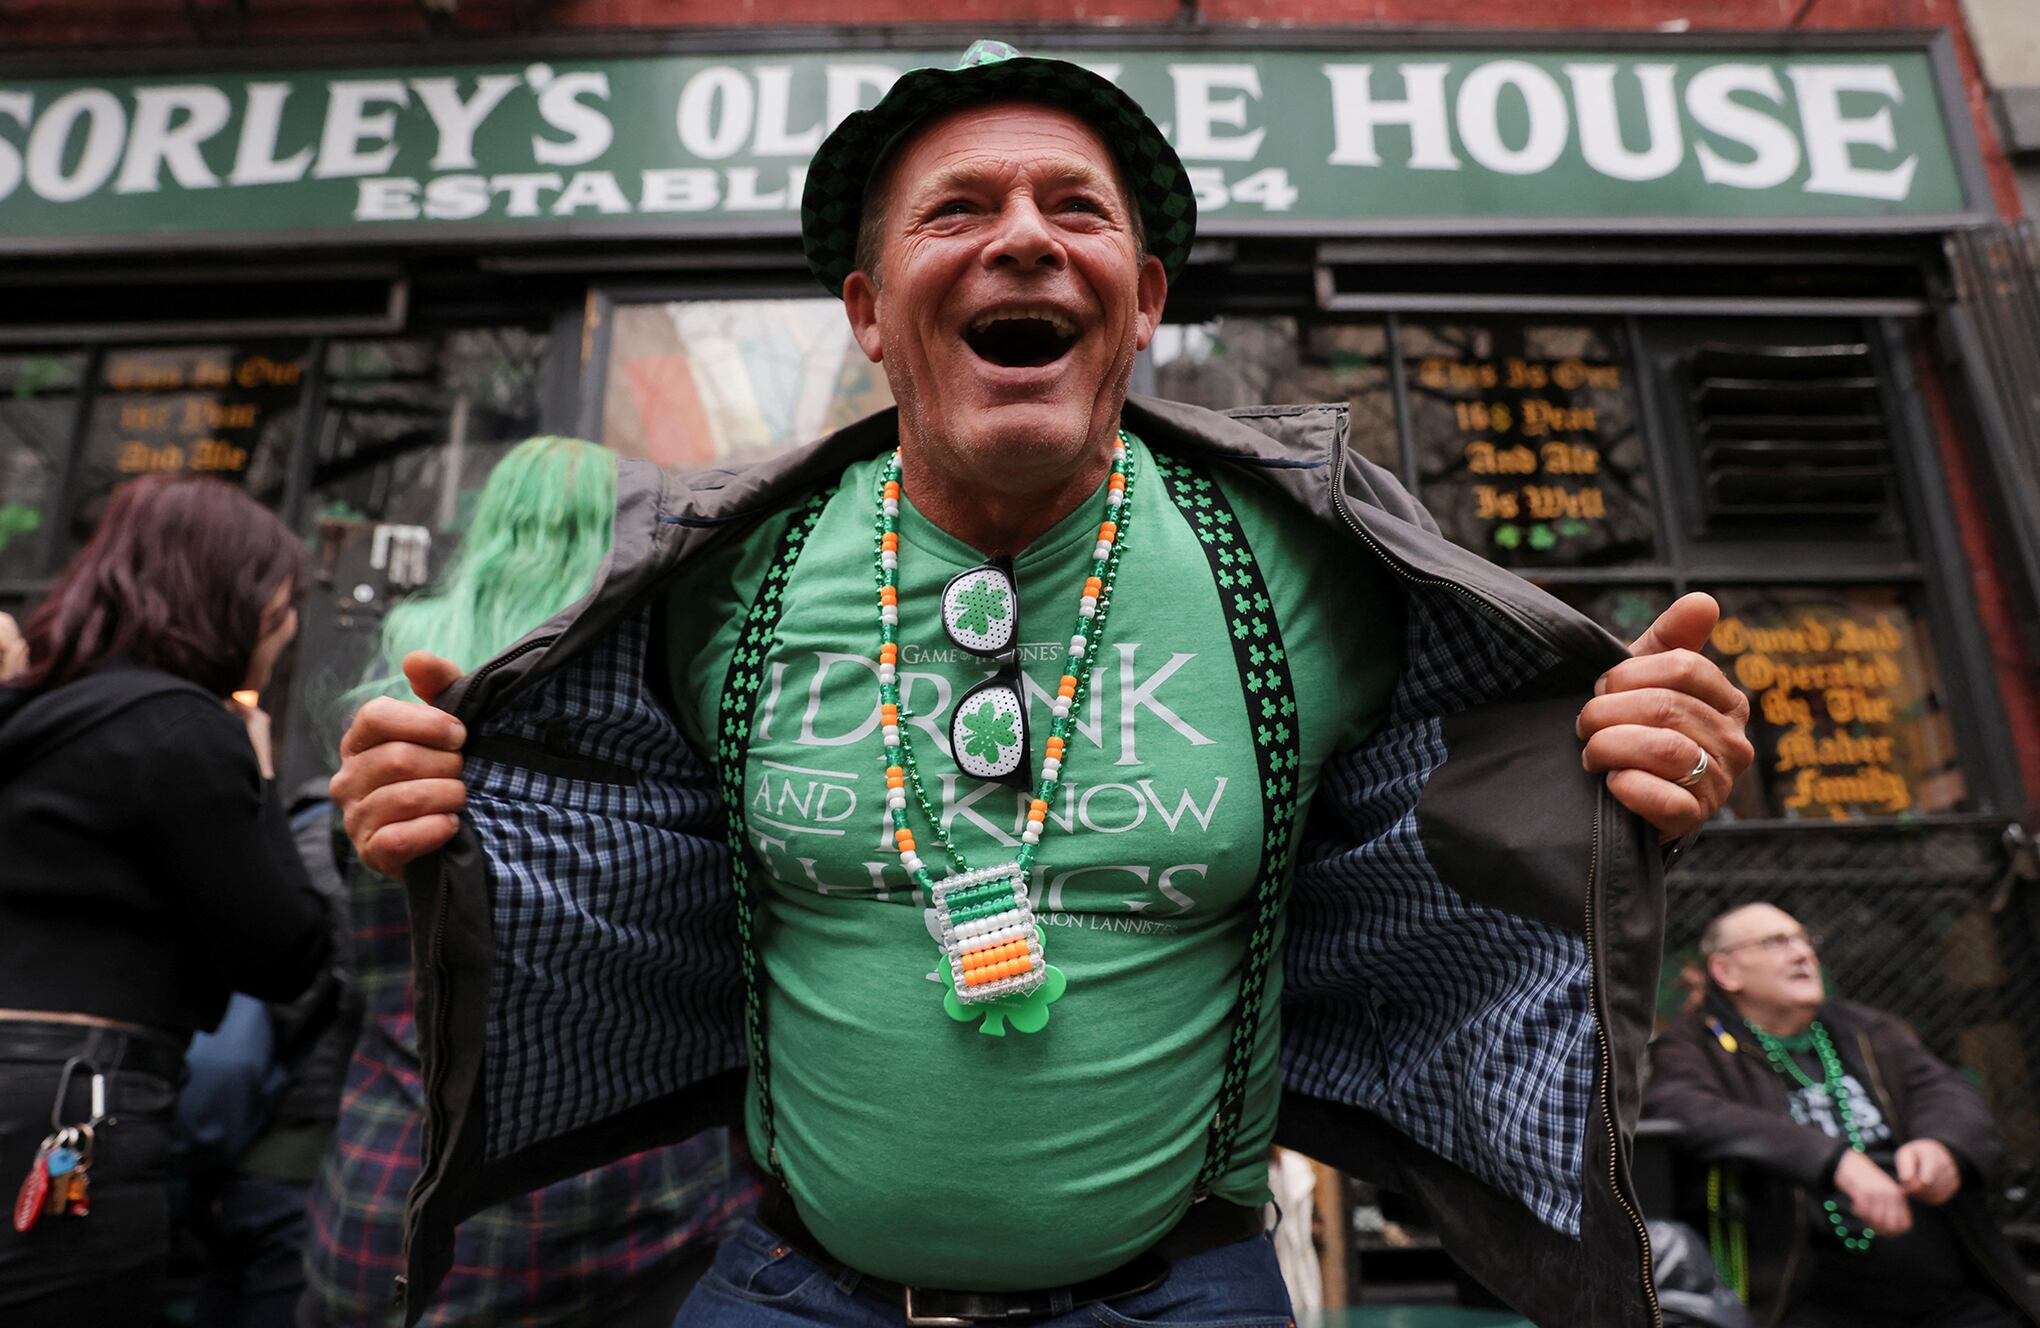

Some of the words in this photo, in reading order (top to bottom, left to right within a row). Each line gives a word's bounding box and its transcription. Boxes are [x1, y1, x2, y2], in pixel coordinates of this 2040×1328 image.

[1322, 60, 1919, 201] HOUSE
[1464, 440, 1537, 475] And
[1522, 484, 1606, 519] Well
[901, 644, 957, 664] GAME
[758, 662, 790, 742] I
[793, 642, 1217, 766] DRNK
[752, 772, 858, 821] AND
[930, 774, 1228, 847] KNOW
